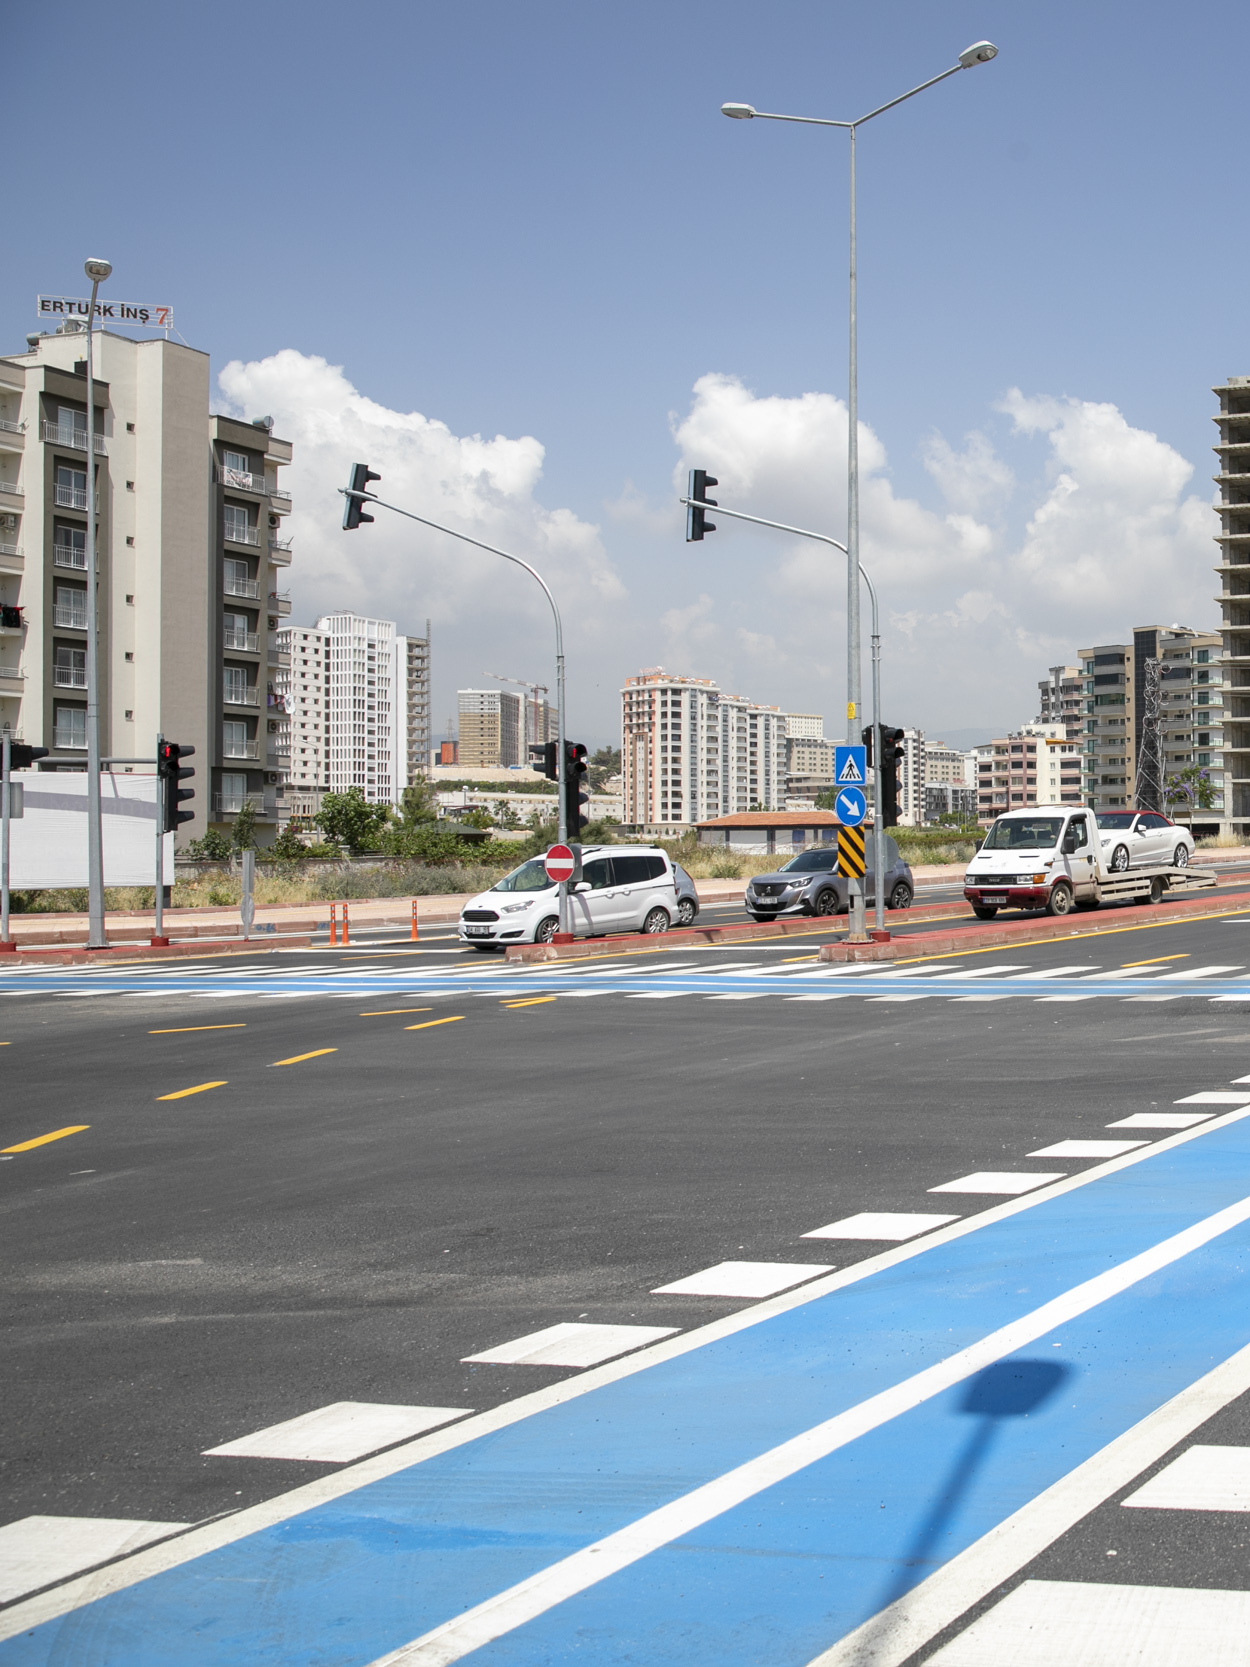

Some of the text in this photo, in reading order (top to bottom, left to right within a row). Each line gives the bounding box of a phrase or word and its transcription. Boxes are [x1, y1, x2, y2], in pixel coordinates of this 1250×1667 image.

[41, 300, 169, 325] ERTÜRK İNŞ 7
